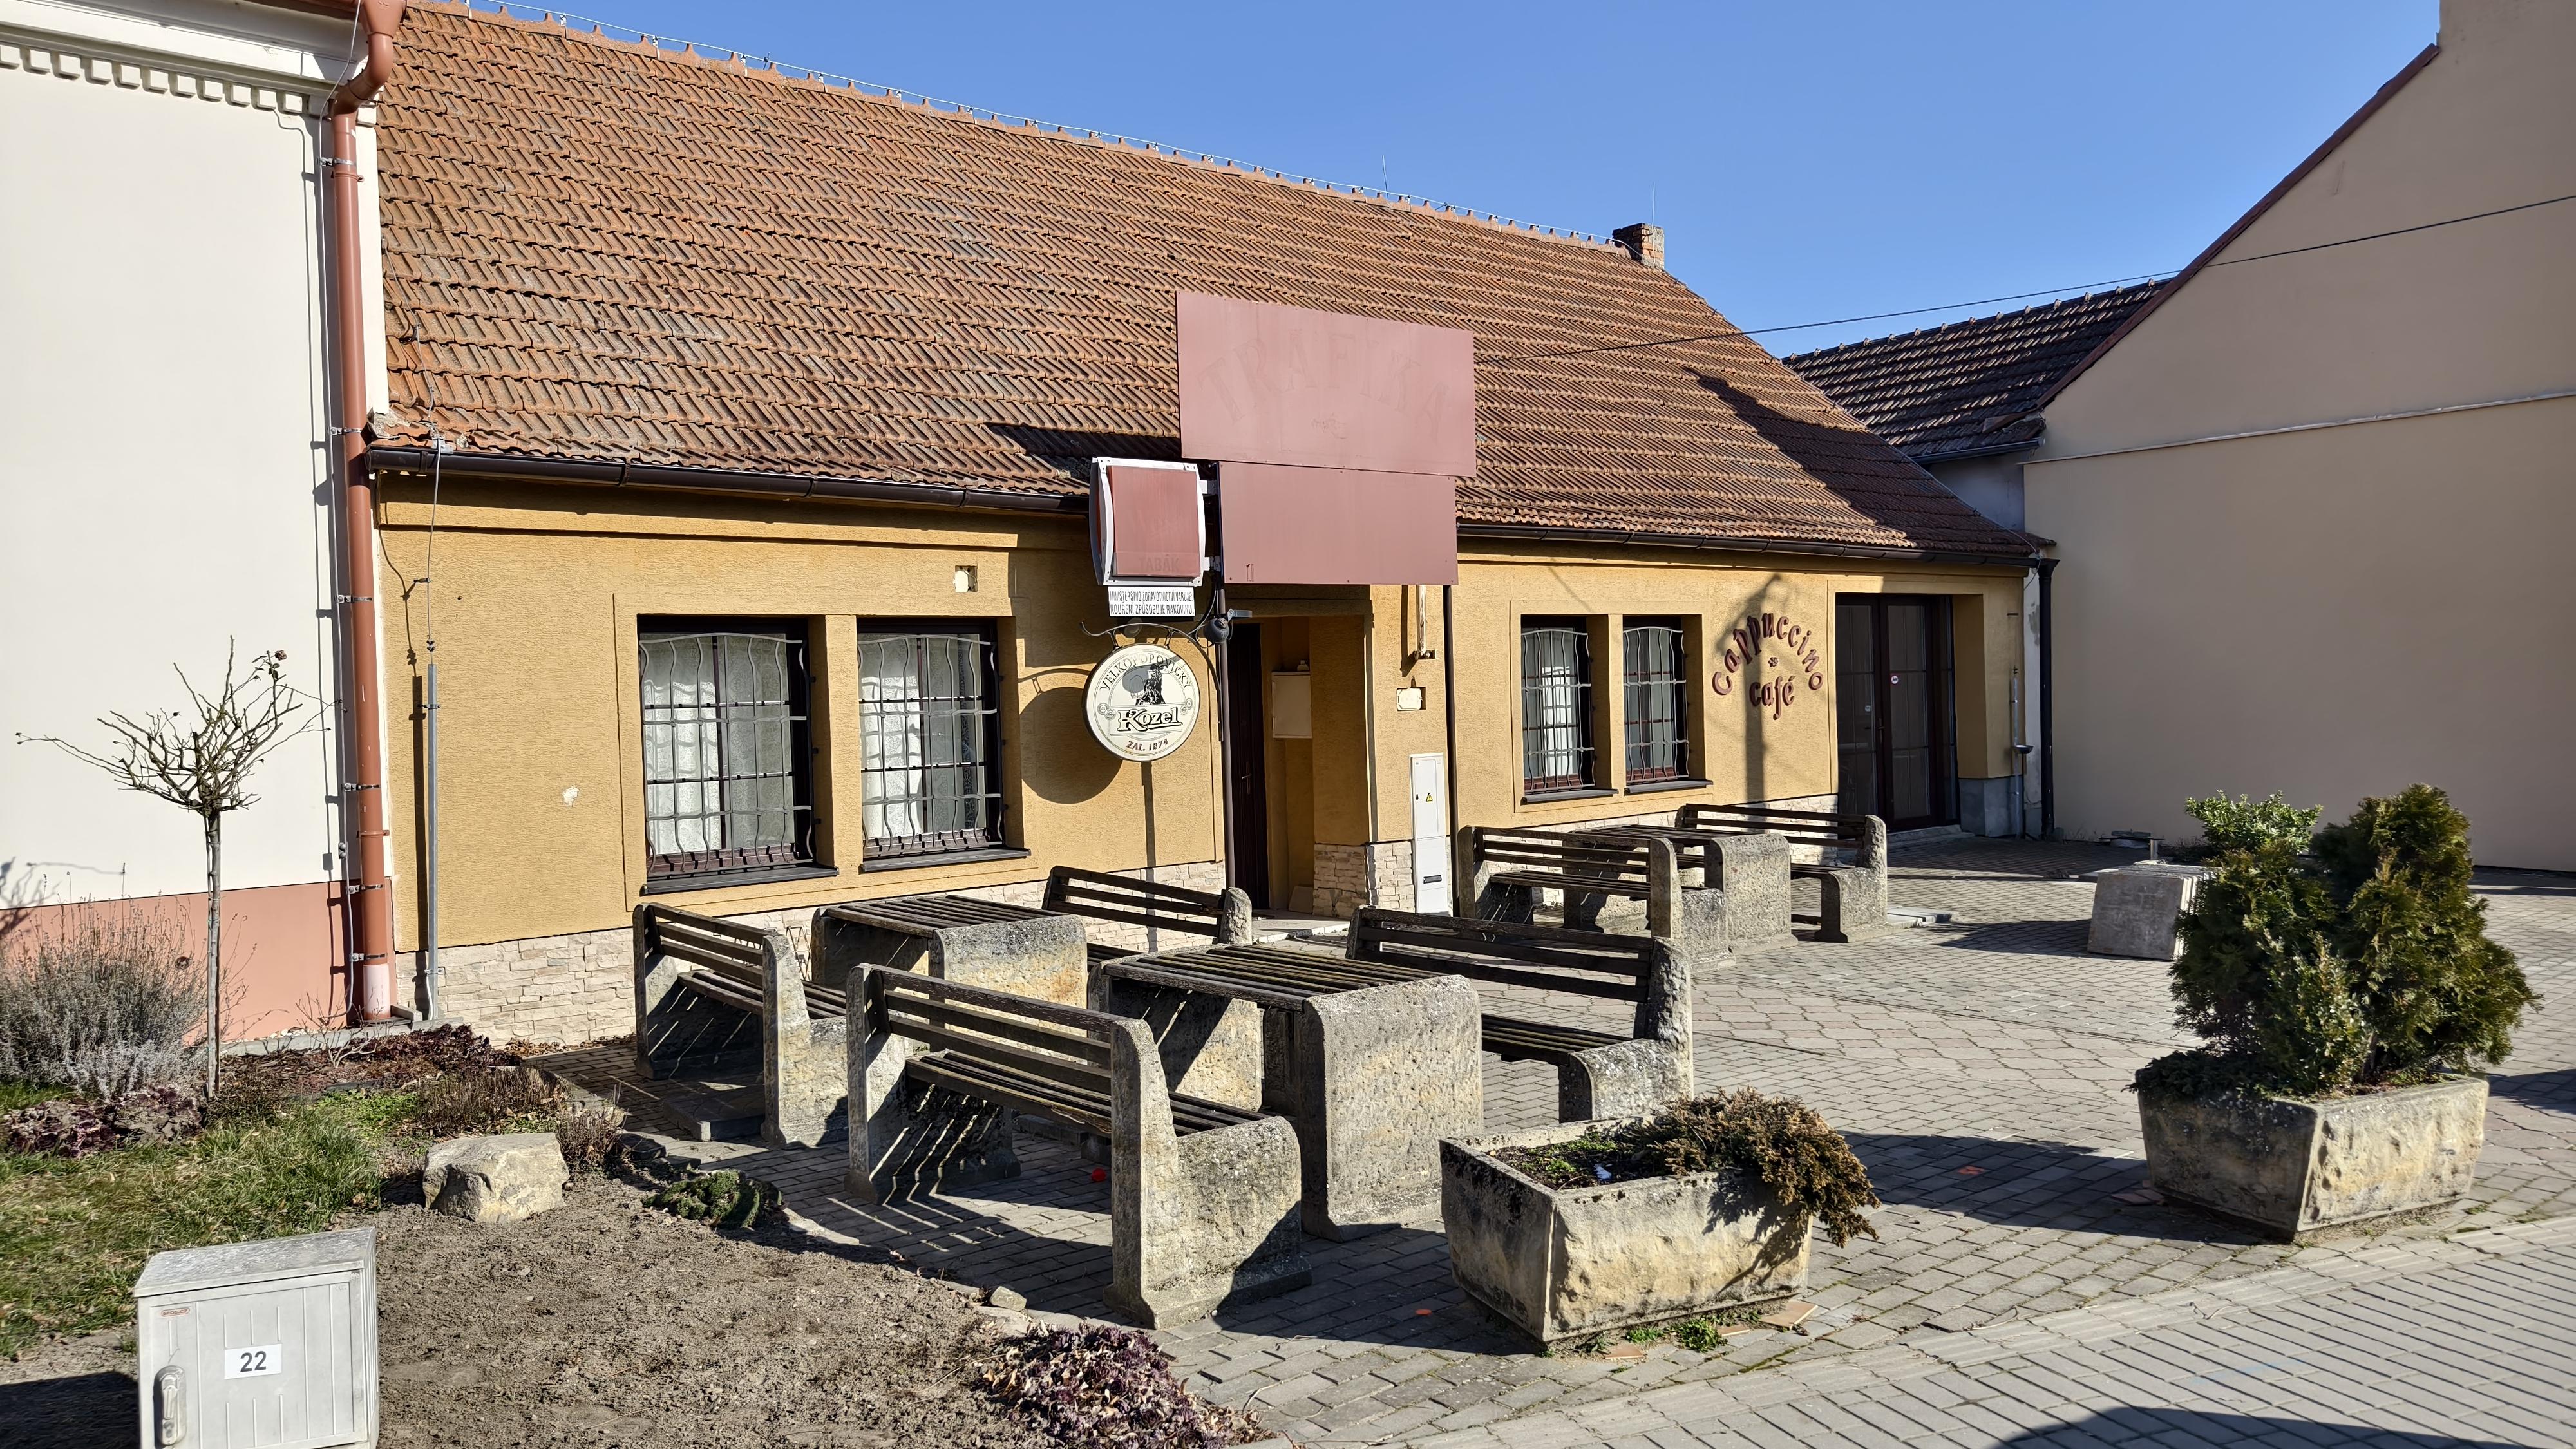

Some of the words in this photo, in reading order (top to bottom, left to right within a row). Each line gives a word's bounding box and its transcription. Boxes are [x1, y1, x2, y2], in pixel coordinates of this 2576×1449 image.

[1109, 591, 1142, 601] MINISTERSTVO
[1142, 589, 1175, 601] ZDRAVOTNICTVÍ
[1110, 601, 1134, 614] KOUŘENÍ
[1135, 601, 1166, 614] ZPŮSOBUJE
[1712, 612, 1824, 696] Cappuccino
[1749, 675, 1796, 721] café
[1117, 707, 1183, 732] Kozel
[1126, 740, 1146, 751] ZAL.
[1148, 738, 1169, 751] 1874
[240, 1350, 267, 1373] 22
